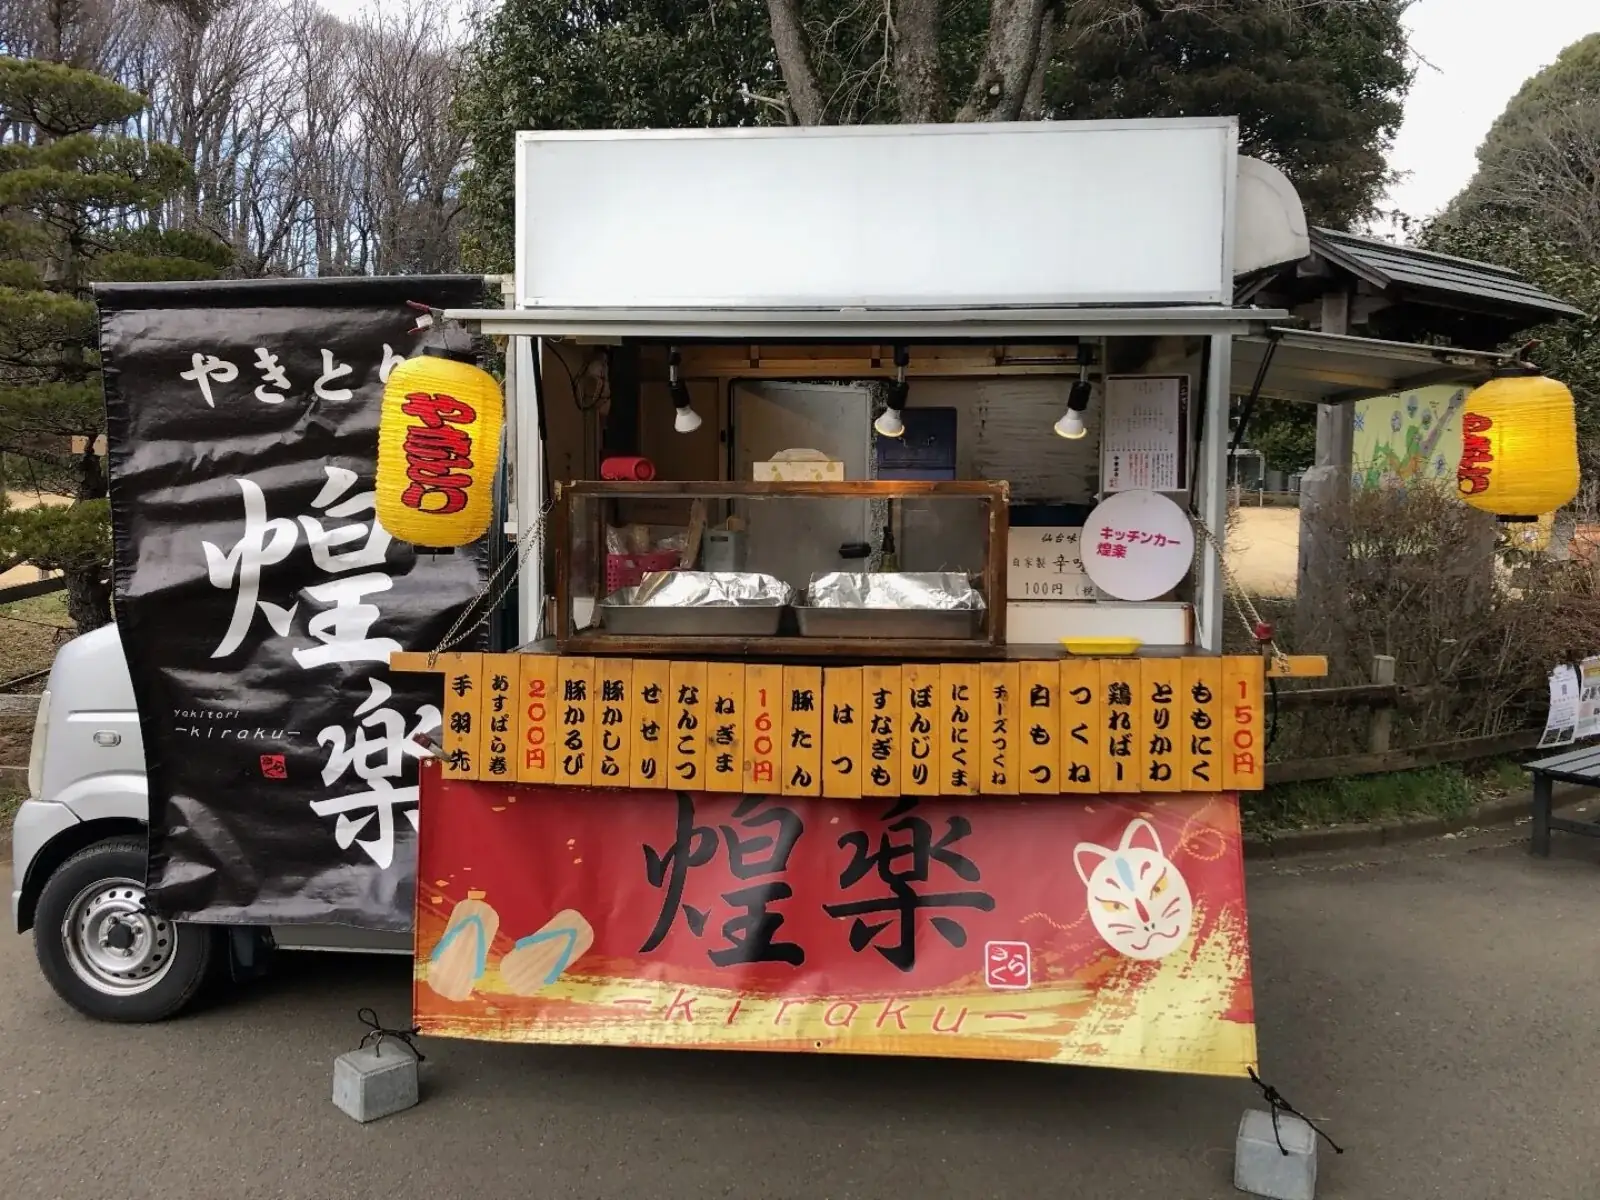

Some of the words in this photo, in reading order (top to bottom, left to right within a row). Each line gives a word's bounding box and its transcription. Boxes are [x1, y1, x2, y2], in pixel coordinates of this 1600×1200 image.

[1099, 527, 1181, 548] キッチンカー
[1025, 582, 1063, 596] 100円
[448, 673, 472, 772] 手羽先
[488, 674, 508, 774] あすぱら巻
[525, 679, 546, 769] 200円
[562, 679, 586, 775] 豚かるび
[601, 679, 623, 776] 豚かしら
[639, 683, 661, 779] せせり
[675, 684, 698, 779] なんこつ
[713, 695, 735, 773] ねぎま
[752, 688, 773, 783] 160円
[790, 689, 813, 787] 豚たん
[831, 703, 853, 774] はつ
[870, 687, 892, 786] すなぎも
[910, 684, 932, 784] ぼんじり
[951, 684, 968, 786] にんにくま
[991, 684, 1007, 784] チーズつくね
[1068, 686, 1091, 782] つくね
[1149, 682, 1172, 781] とりかわ
[1190, 681, 1212, 781] ももにく
[1232, 680, 1255, 774] 150円
[638, 793, 996, 973] 煌楽
